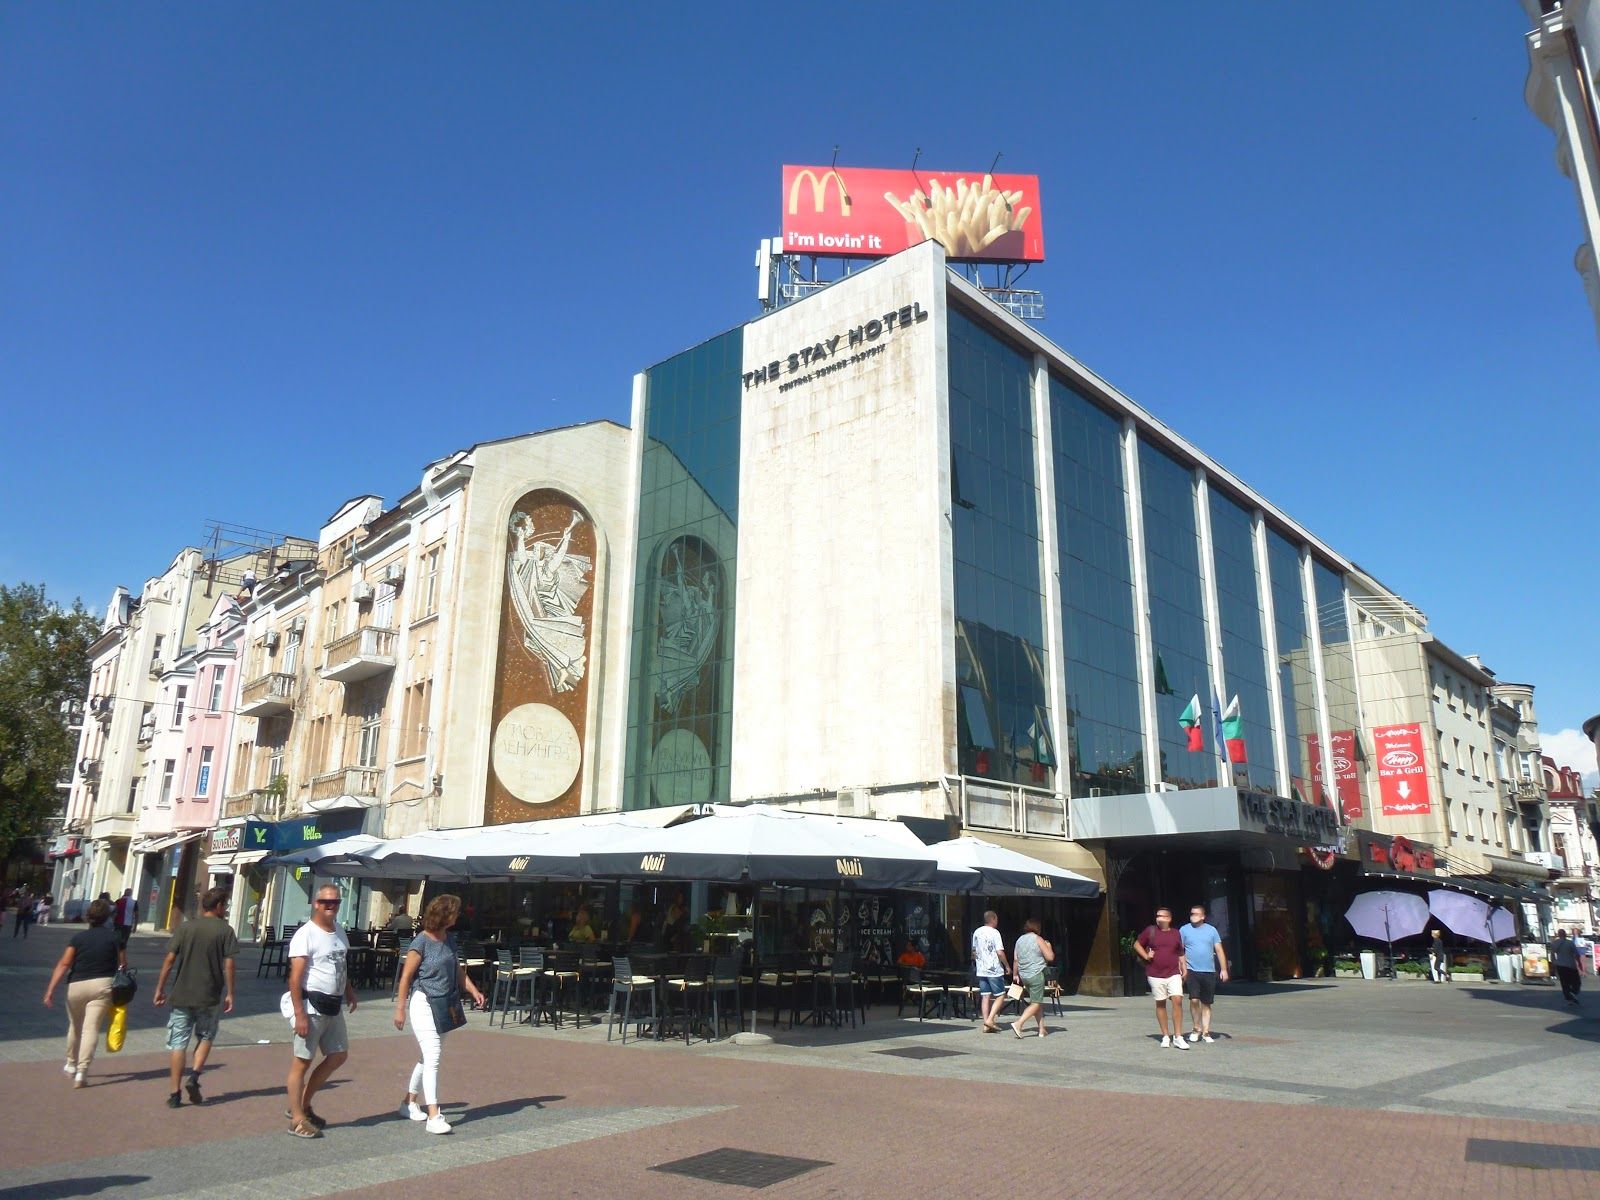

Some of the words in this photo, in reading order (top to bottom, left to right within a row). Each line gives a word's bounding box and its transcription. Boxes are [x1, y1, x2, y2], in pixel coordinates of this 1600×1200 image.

[788, 231, 815, 247] i'm
[818, 232, 865, 248] lovin'
[868, 234, 882, 249] it
[742, 360, 780, 392] THE
[787, 334, 840, 374] STAY
[849, 301, 929, 350] HOTEL
[1379, 769, 1395, 777] Bar
[1404, 765, 1424, 775] Grill
[211, 835, 240, 850] SOUVENIRS
[817, 928, 843, 936] BAKEY
[860, 928, 871, 936] ICE
[872, 928, 892, 936] CREAM
